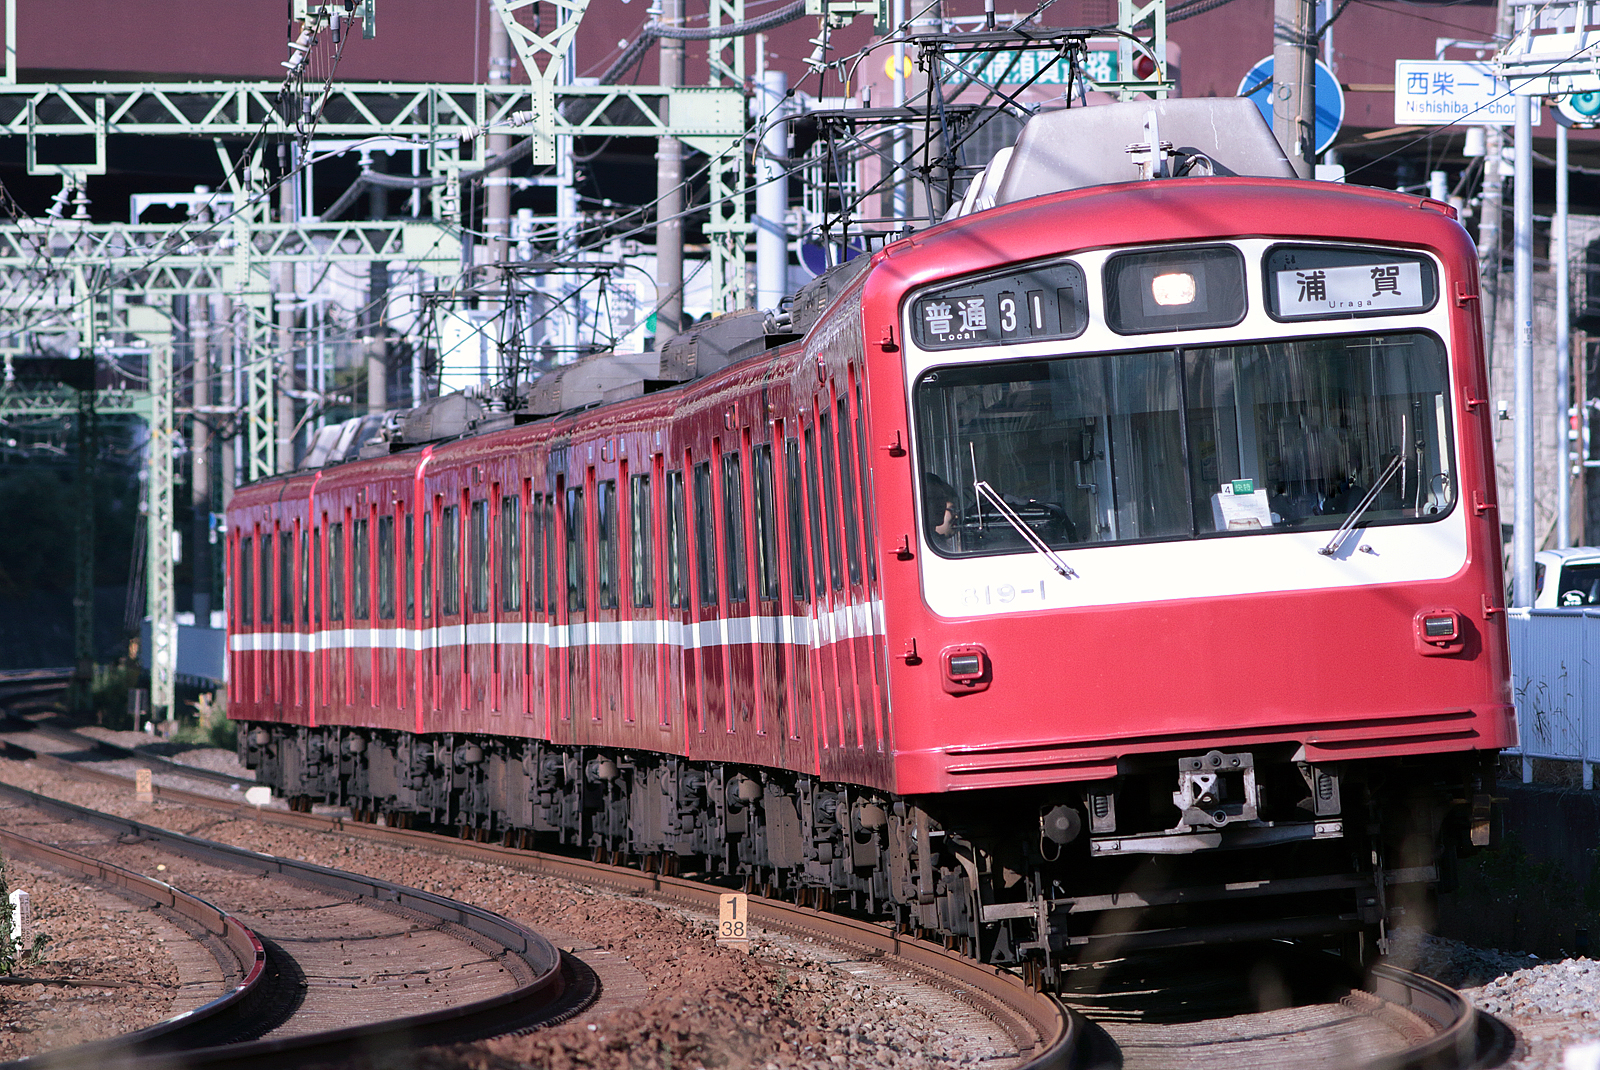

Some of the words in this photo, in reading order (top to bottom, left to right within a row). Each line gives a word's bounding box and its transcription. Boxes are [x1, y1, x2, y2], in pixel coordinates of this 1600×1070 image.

[1407, 72, 1515, 96] 西柴一丁
[1406, 101, 1468, 113] Nishishiba
[1296, 266, 1402, 302] 浦賀
[1328, 300, 1372, 309] Uraga
[925, 298, 987, 335] 普通
[939, 331, 976, 342] Local
[1224, 486, 1231, 494] 4
[726, 897, 737, 920] 1
[722, 921, 745, 937] 38
